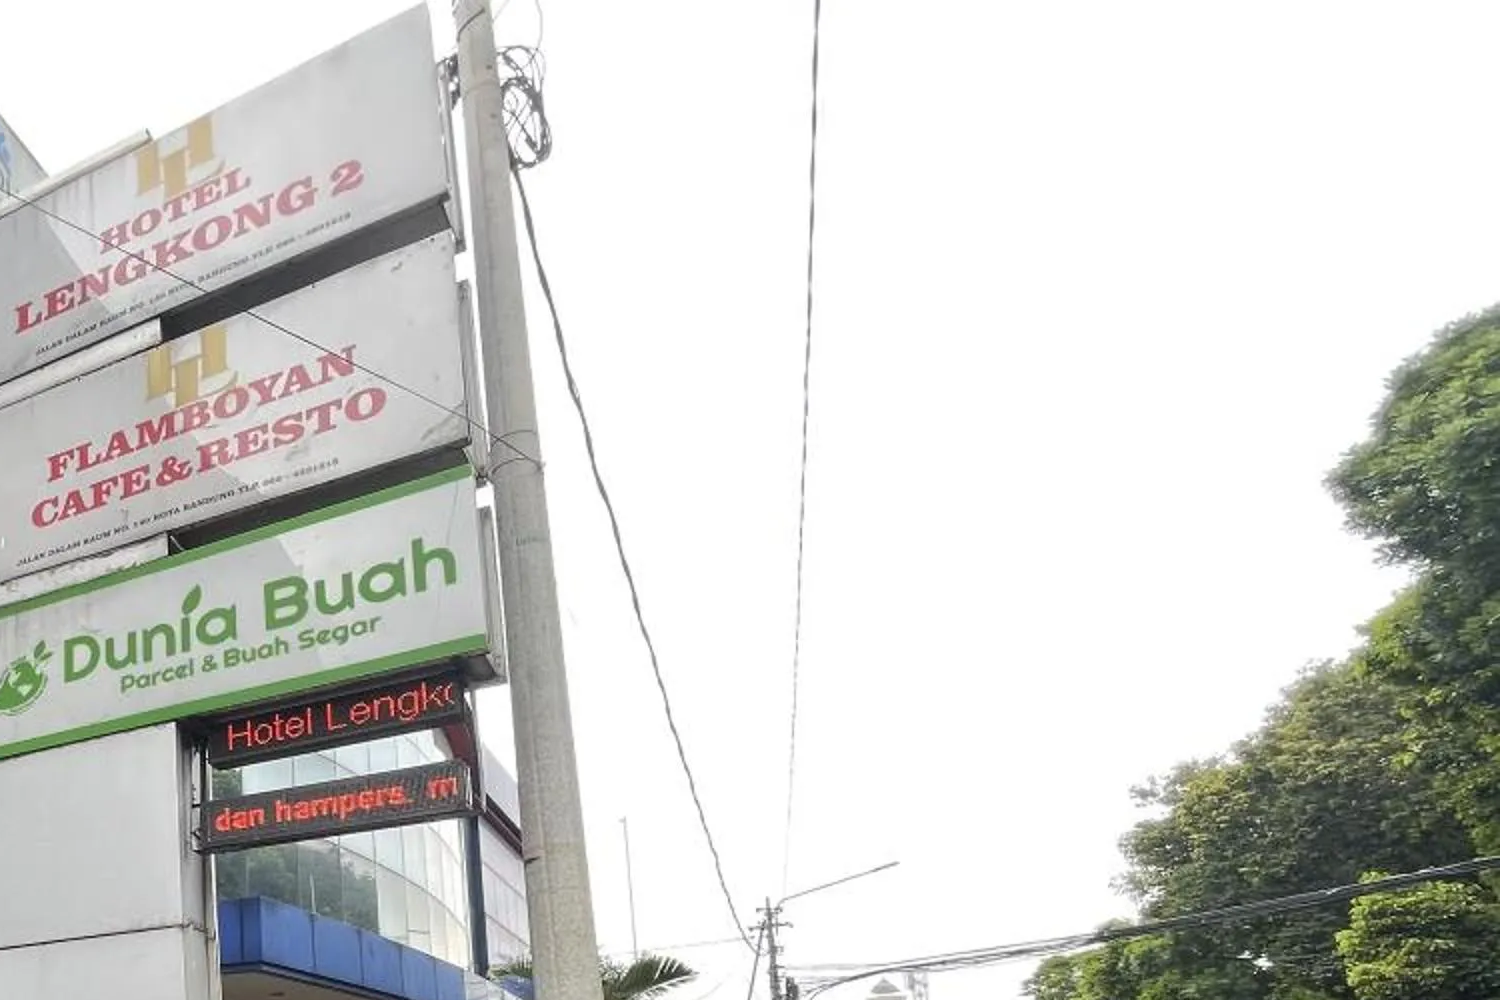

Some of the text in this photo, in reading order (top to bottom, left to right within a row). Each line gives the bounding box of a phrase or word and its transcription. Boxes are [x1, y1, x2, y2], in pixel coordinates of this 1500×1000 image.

[15, 159, 365, 334] LENGKONG 2
[100, 167, 252, 255] HOTEL
[46, 344, 357, 483] FLAMBOYAN
[63, 537, 457, 683] Dunia Buah
[120, 614, 382, 694] Parcel & Buah Segar
[227, 707, 313, 751] Hotel
[215, 804, 265, 833] dan
